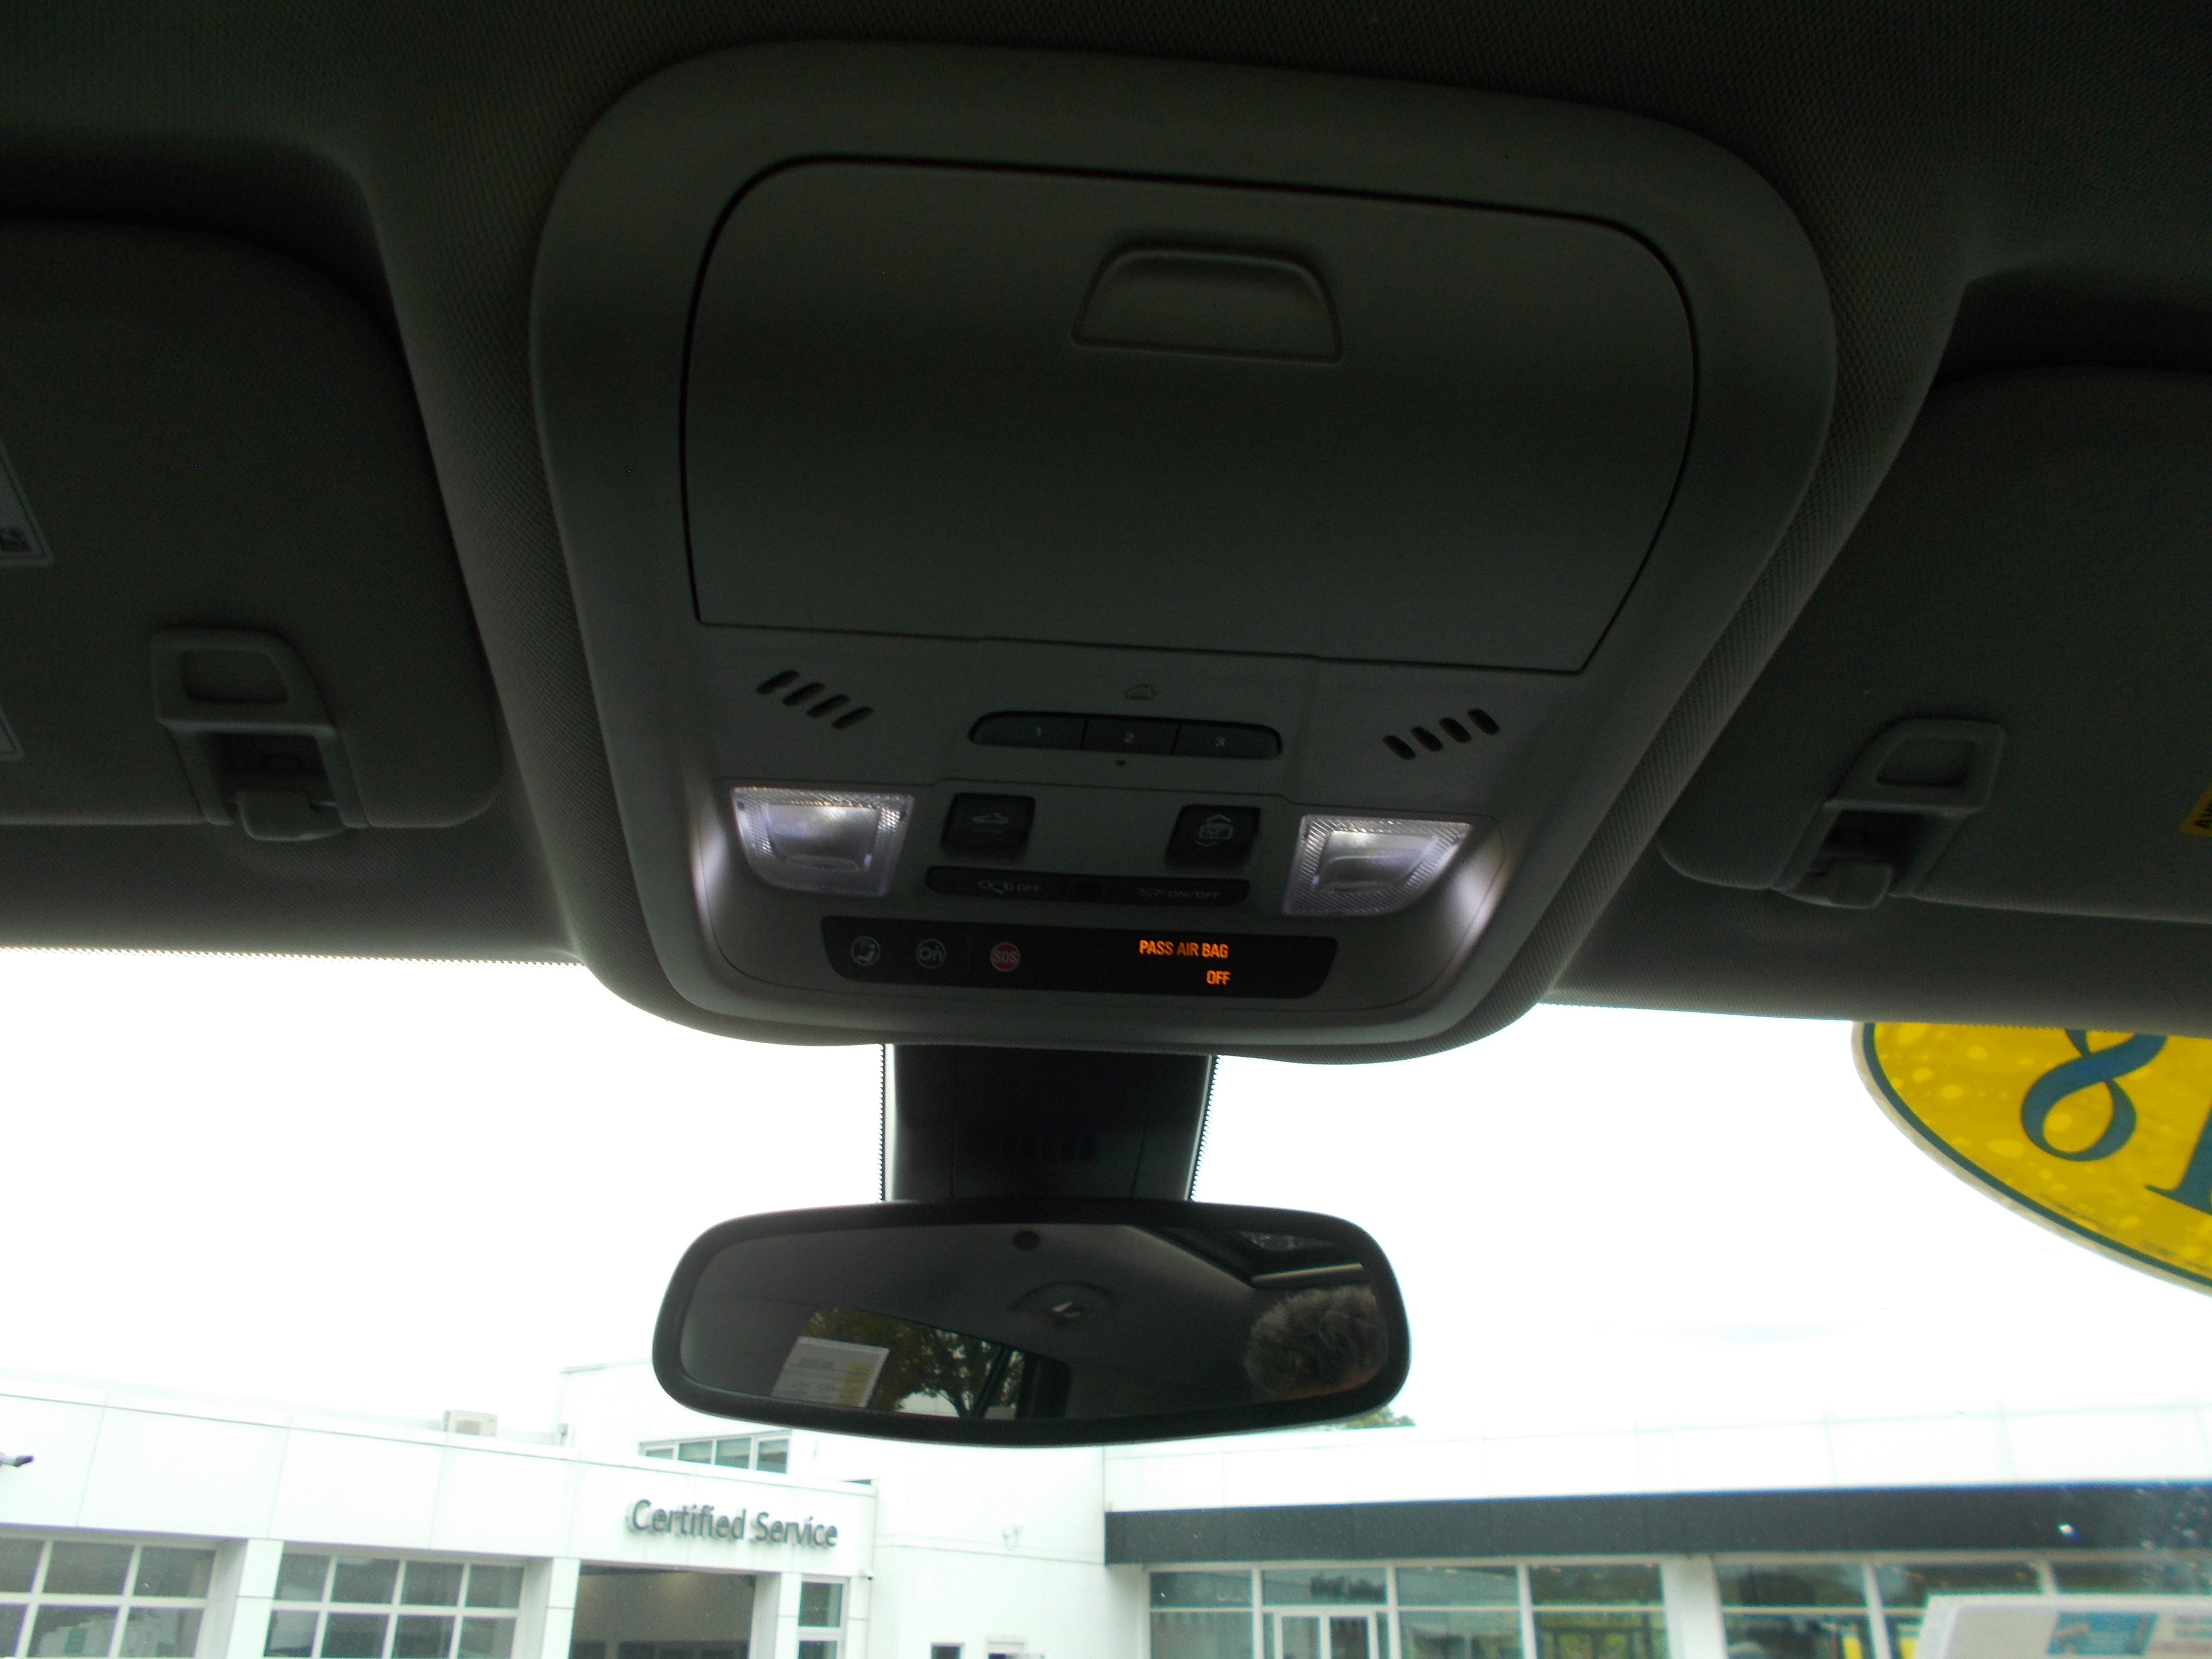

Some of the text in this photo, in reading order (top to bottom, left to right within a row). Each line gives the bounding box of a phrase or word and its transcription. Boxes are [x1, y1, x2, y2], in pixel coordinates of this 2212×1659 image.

[1123, 732, 1135, 744] 2
[1139, 939, 1229, 959] PASS AIR BAG
[993, 951, 1019, 963] SOS
[1206, 970, 1231, 985] OFF
[627, 1498, 838, 1548] Certified Service
